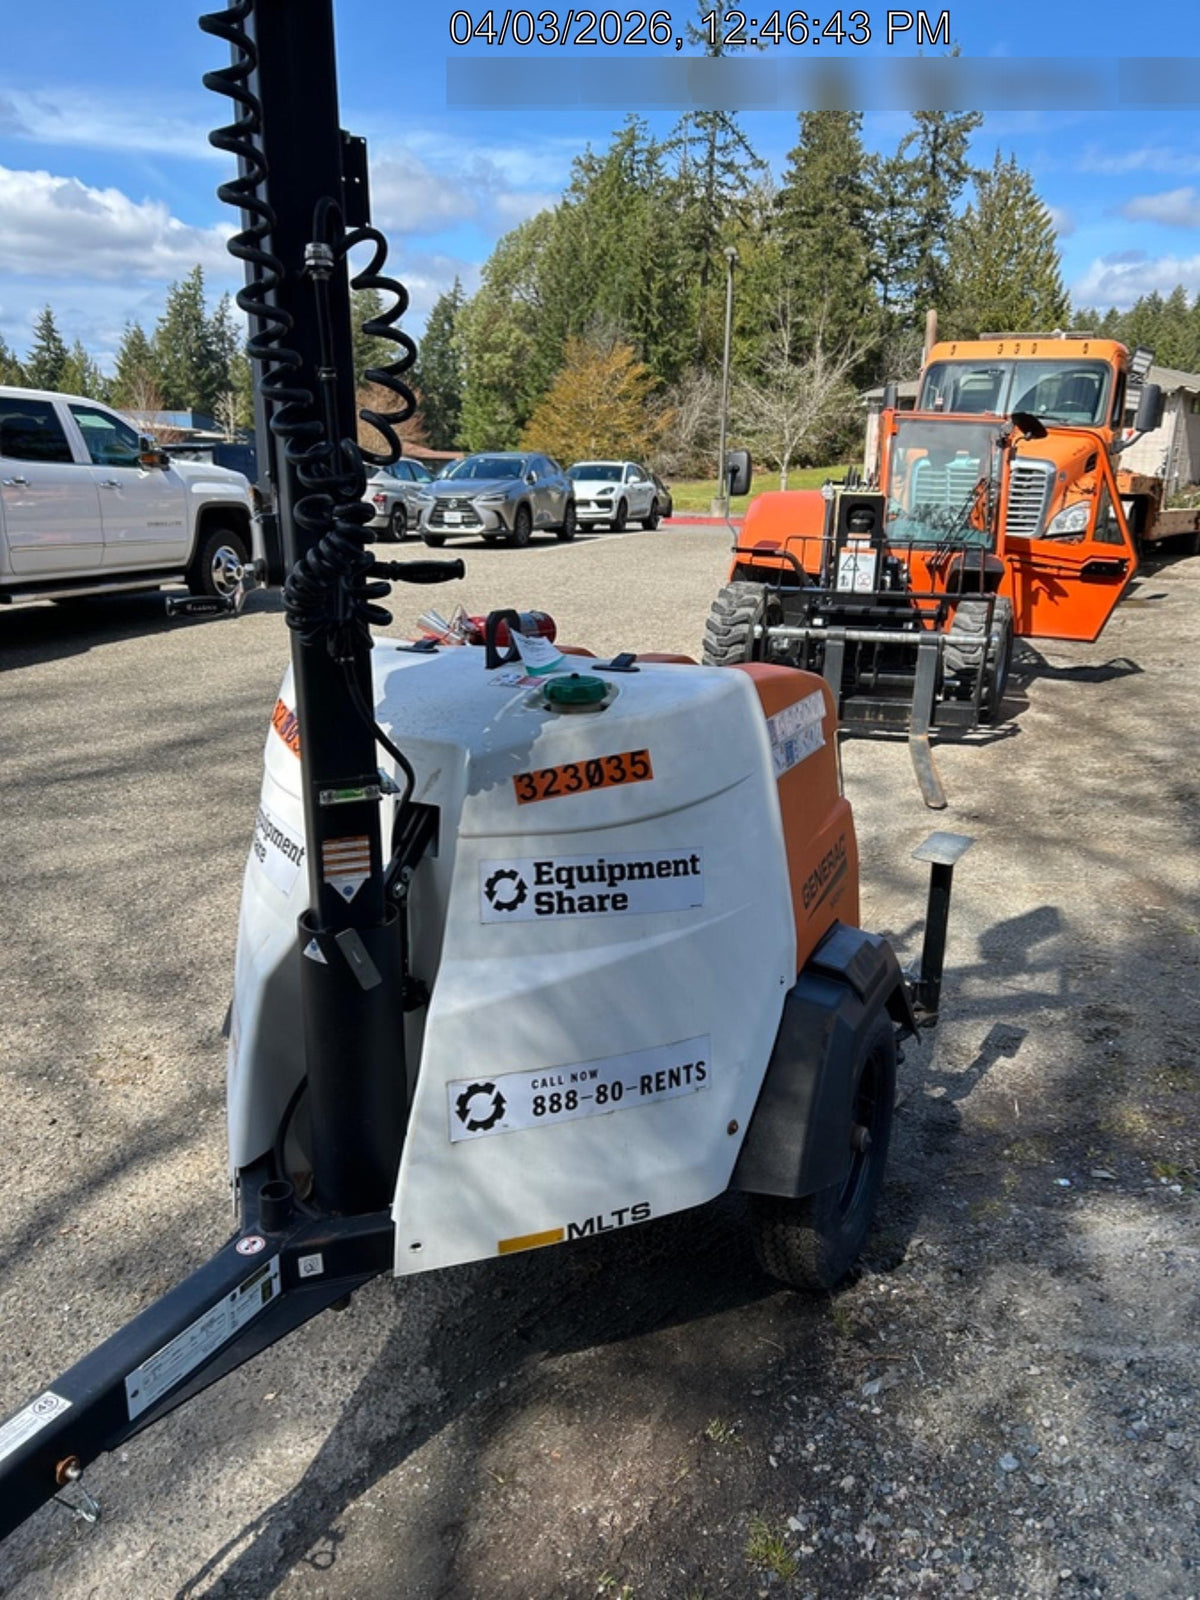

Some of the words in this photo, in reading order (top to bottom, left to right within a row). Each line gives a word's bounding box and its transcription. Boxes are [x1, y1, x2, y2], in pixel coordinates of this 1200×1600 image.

[518, 750, 650, 801] 323035
[533, 853, 700, 889] Equipment
[802, 833, 846, 910] GENERAC
[534, 891, 628, 916] Share
[531, 1077, 564, 1090] CALL
[570, 1069, 599, 1083] NOW
[532, 1061, 707, 1117] 888-80-RENTS
[567, 1201, 651, 1241] MLTS
